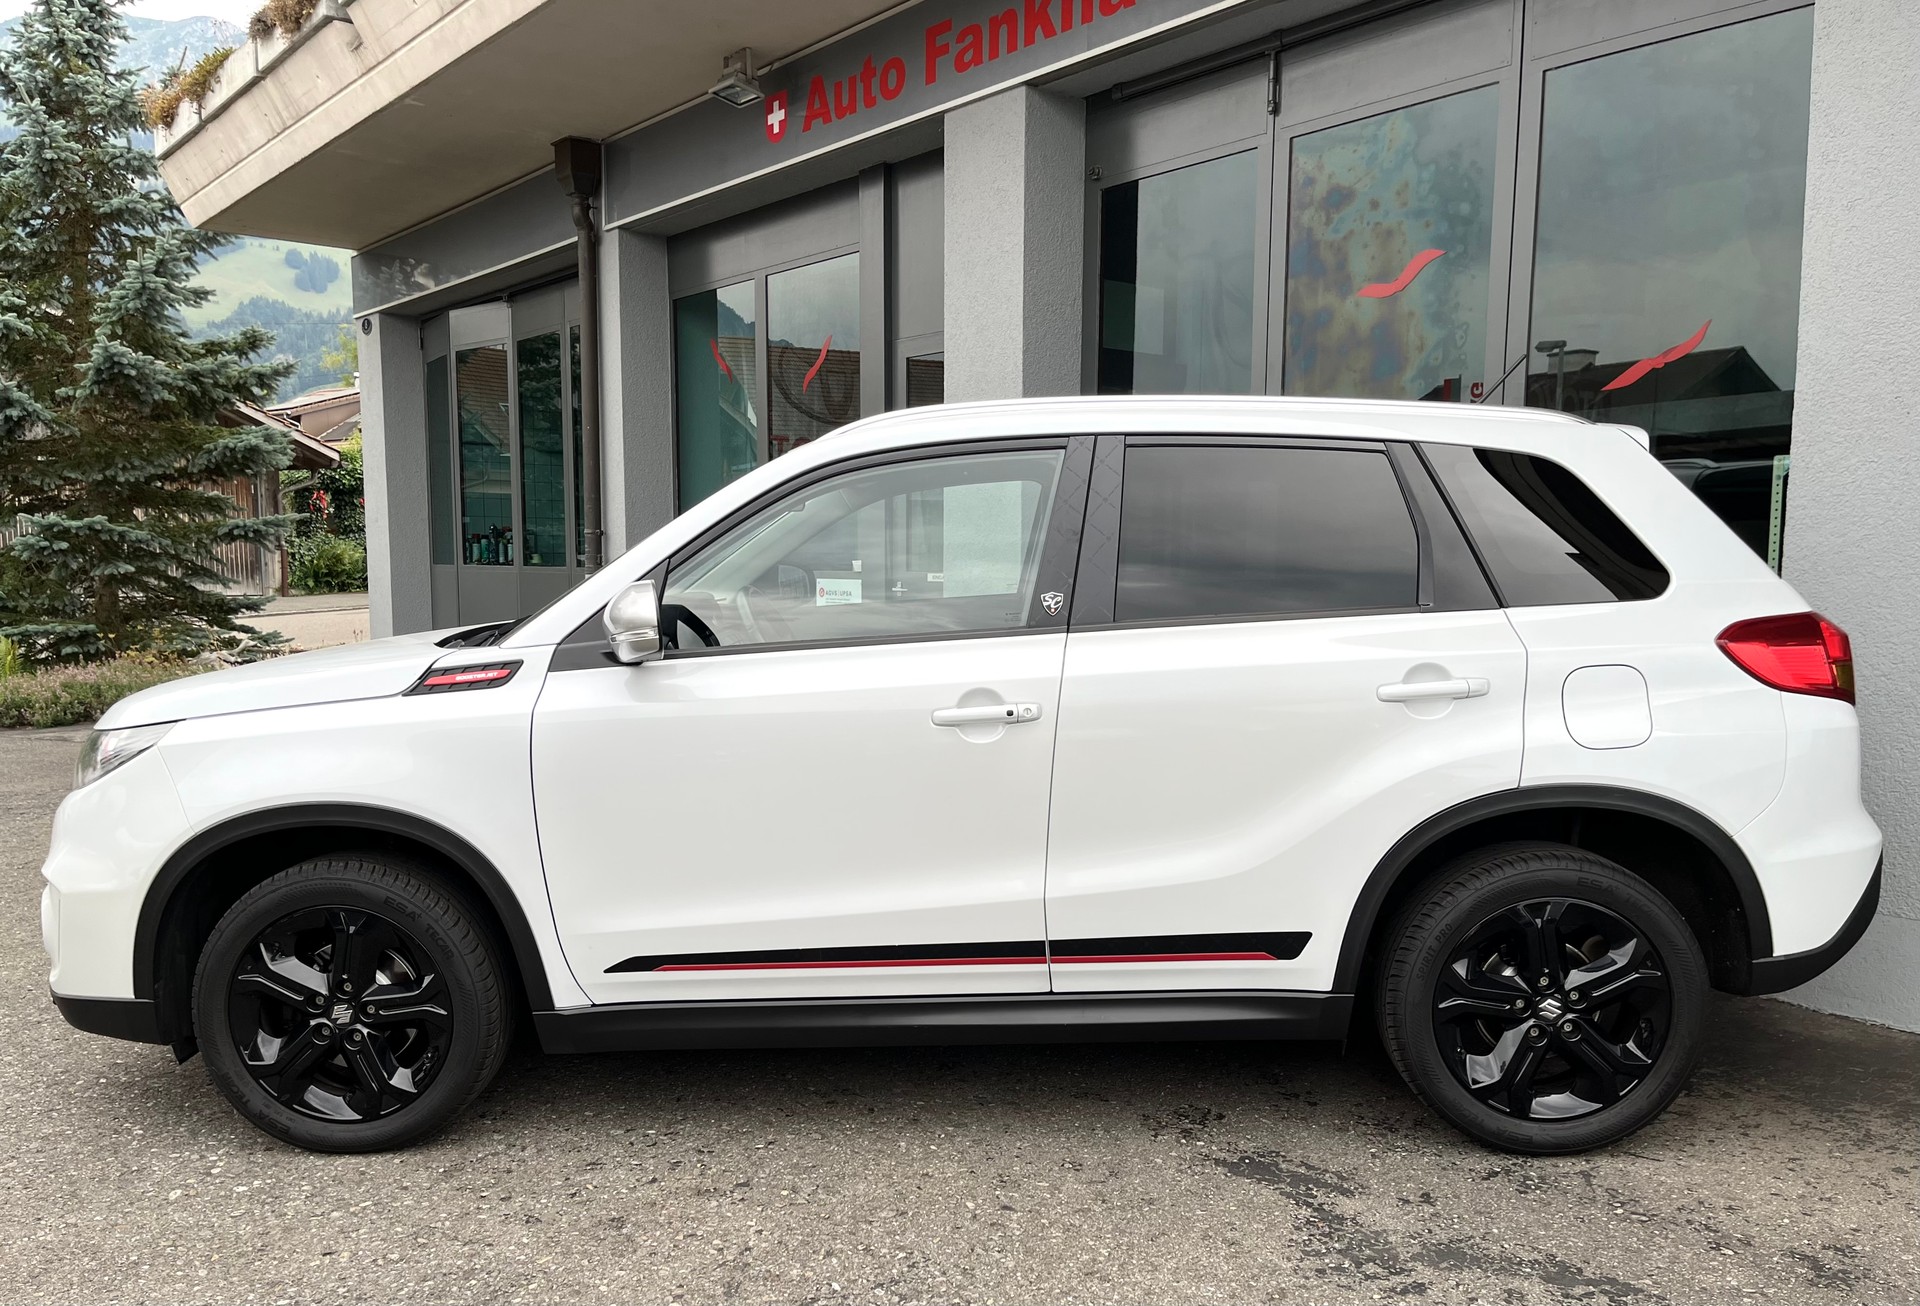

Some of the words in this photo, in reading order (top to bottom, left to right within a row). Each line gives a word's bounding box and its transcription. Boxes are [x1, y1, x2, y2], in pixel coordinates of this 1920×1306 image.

[802, 53, 906, 133] Auto
[1416, 945, 1436, 981] SPIRIT
[1435, 923, 1453, 944] PRO
